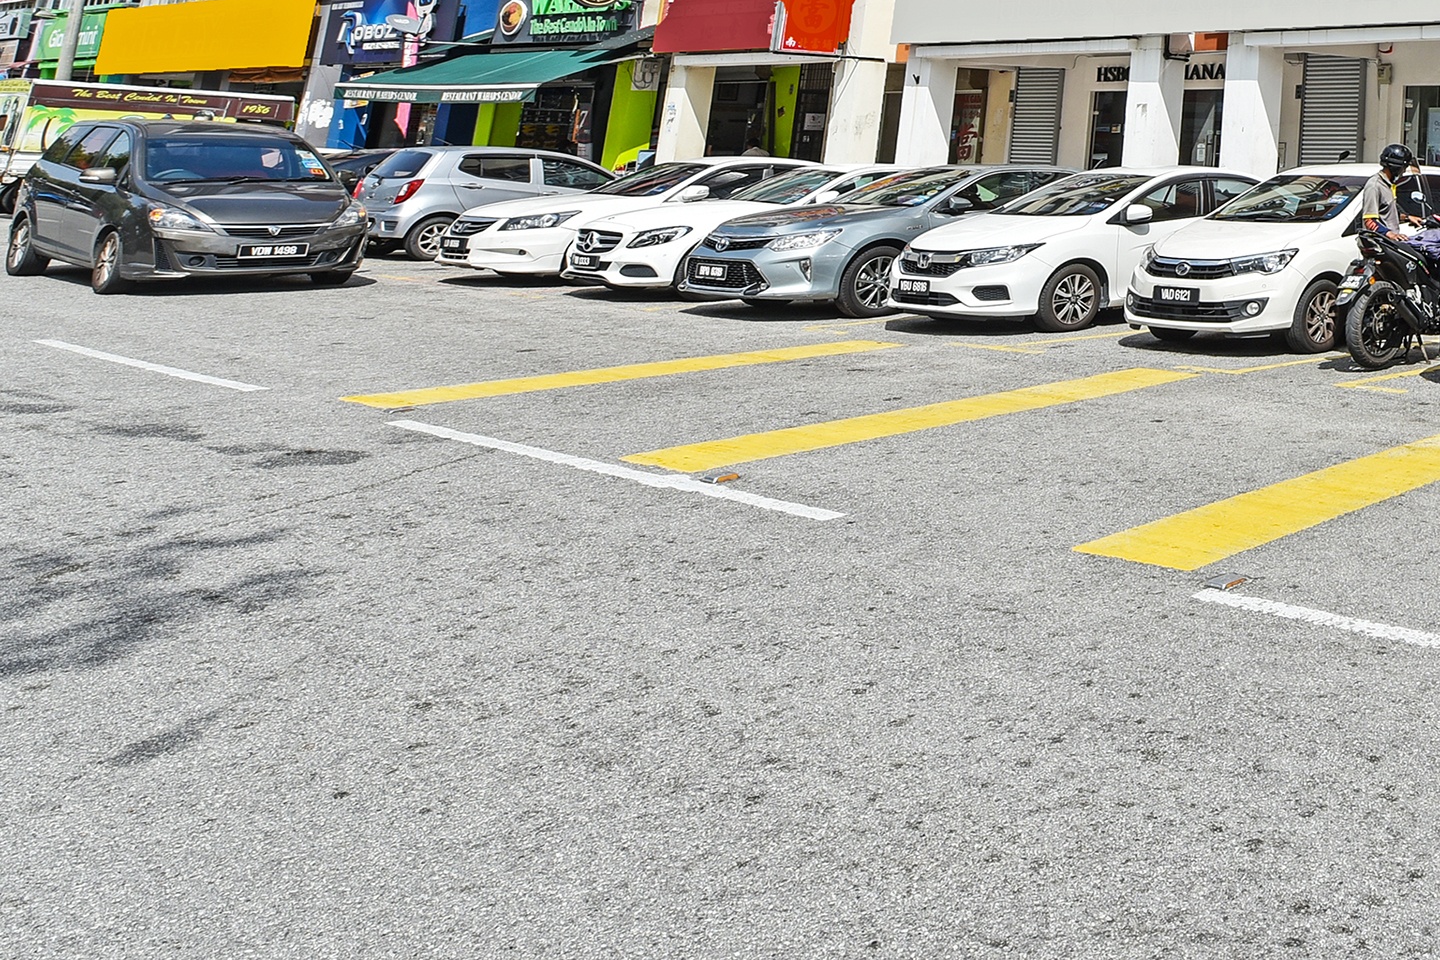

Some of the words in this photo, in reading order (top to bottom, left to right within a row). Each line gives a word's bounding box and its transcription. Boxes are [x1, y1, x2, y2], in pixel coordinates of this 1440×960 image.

[543, 18, 560, 34] Best
[72, 89, 92, 98] The
[96, 90, 121, 99] Best
[124, 92, 161, 102] Cendol
[165, 95, 177, 103] In
[180, 96, 207, 105] Town
[274, 246, 298, 255] 1498
[1161, 288, 1174, 300] VAD
[1175, 289, 1190, 301] 6121
